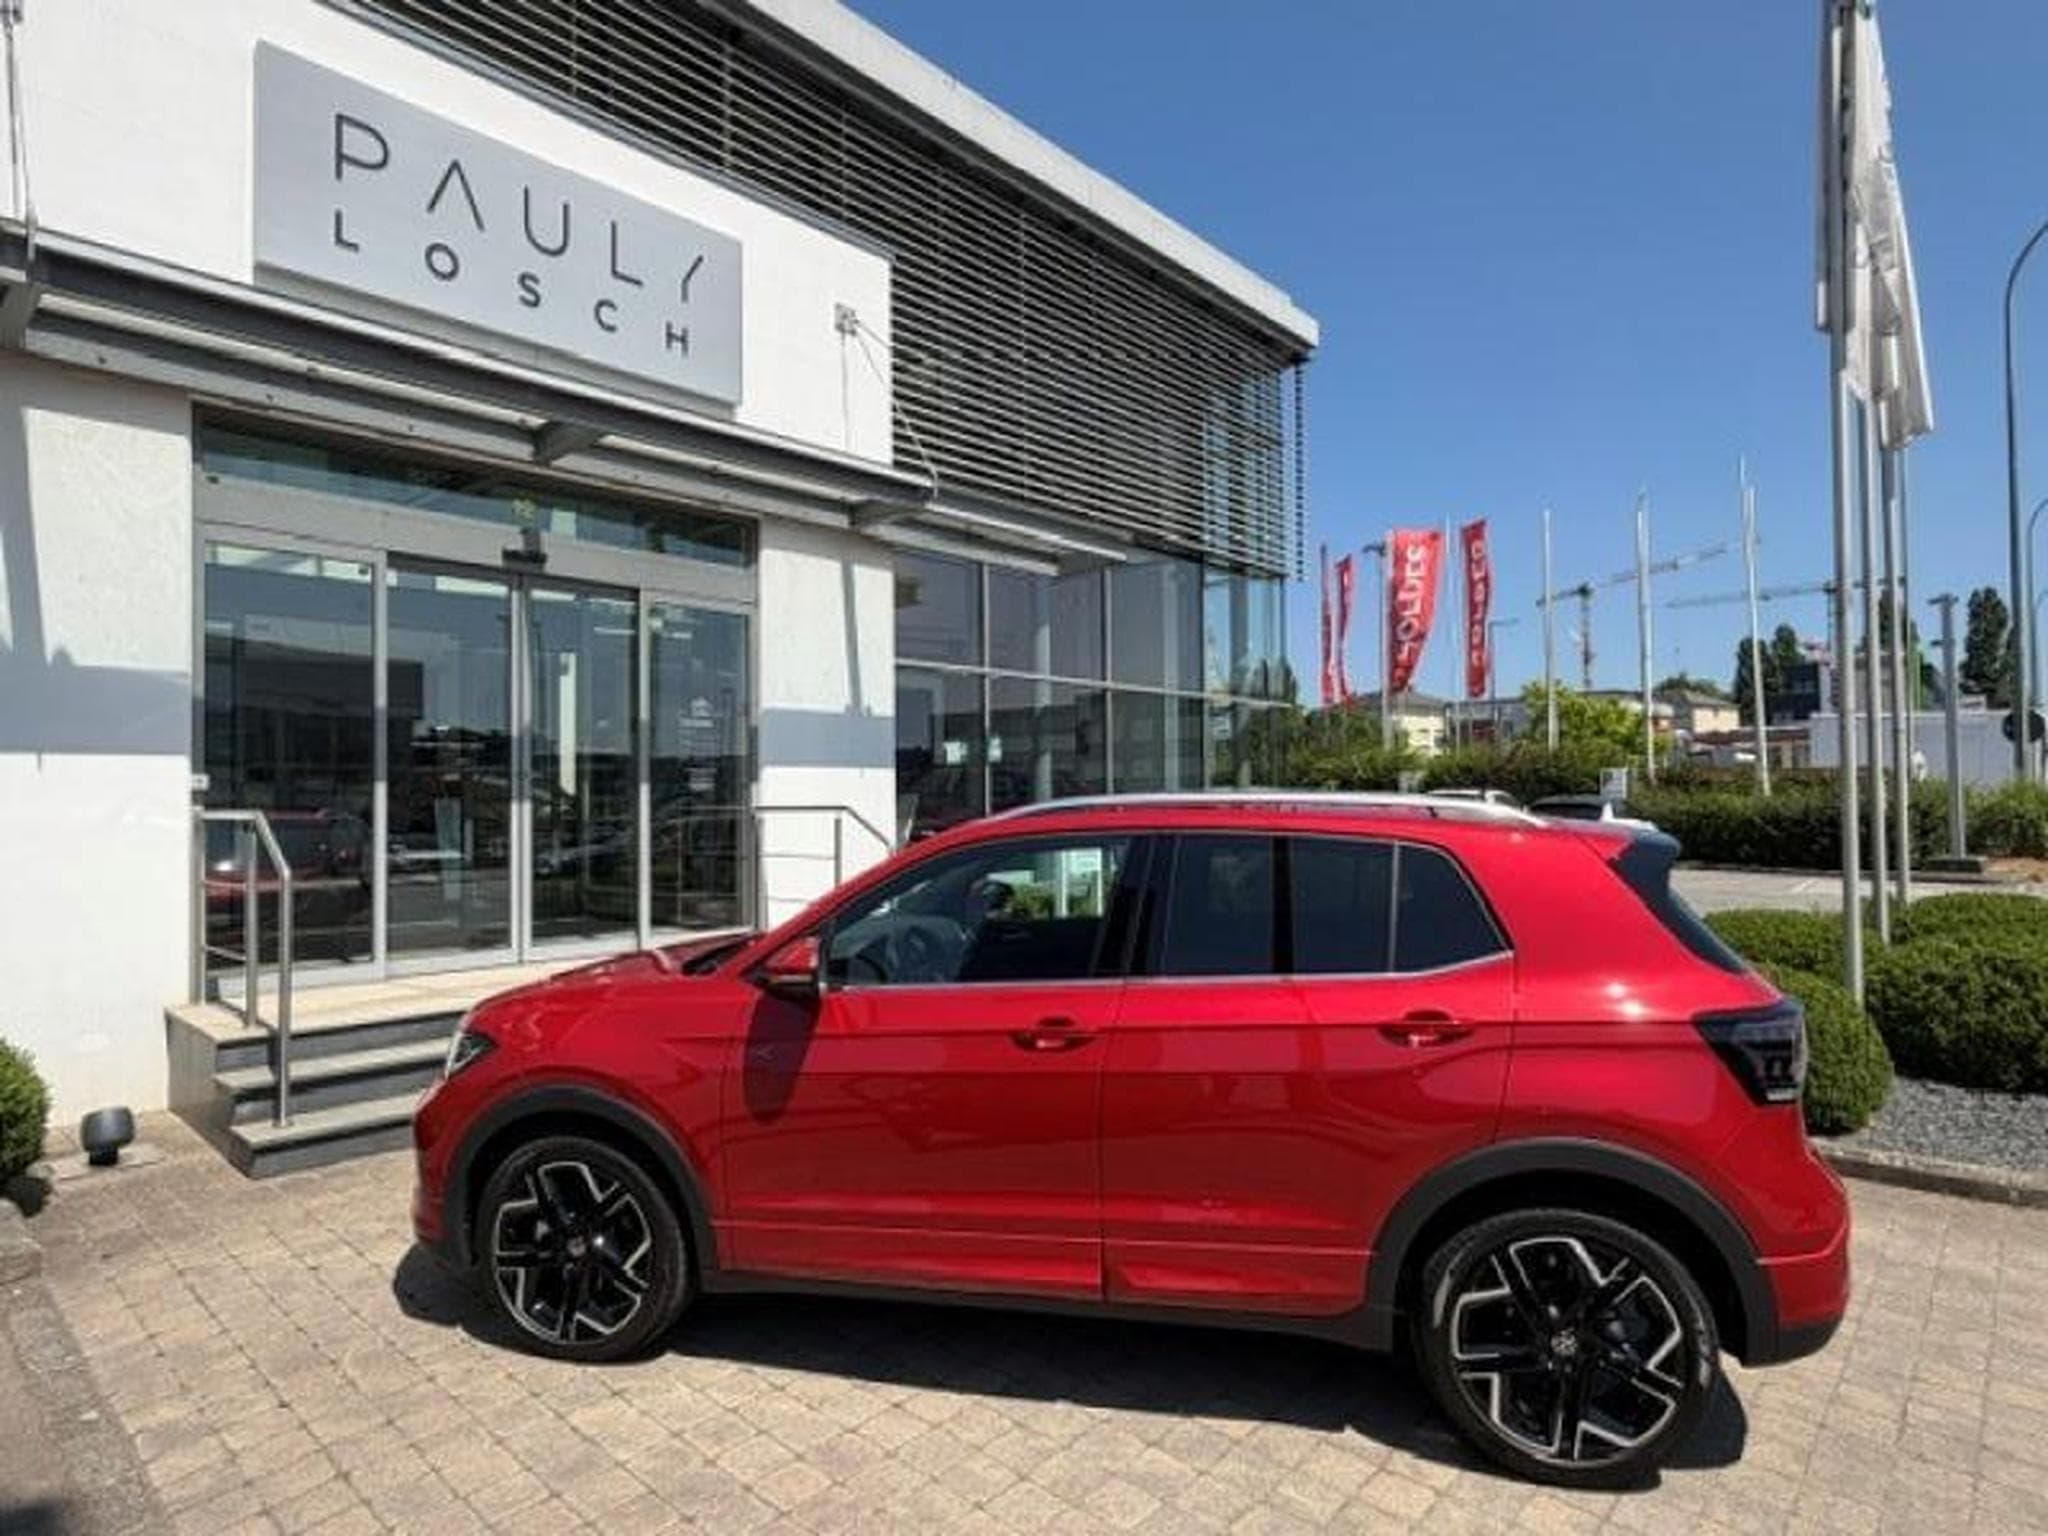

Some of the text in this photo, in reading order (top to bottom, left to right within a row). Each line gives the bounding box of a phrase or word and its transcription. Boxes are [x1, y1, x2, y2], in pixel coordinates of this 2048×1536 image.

[334, 113, 704, 303] PAULY
[334, 210, 691, 357] LOSCH
[1395, 544, 1425, 665] SOLDES
